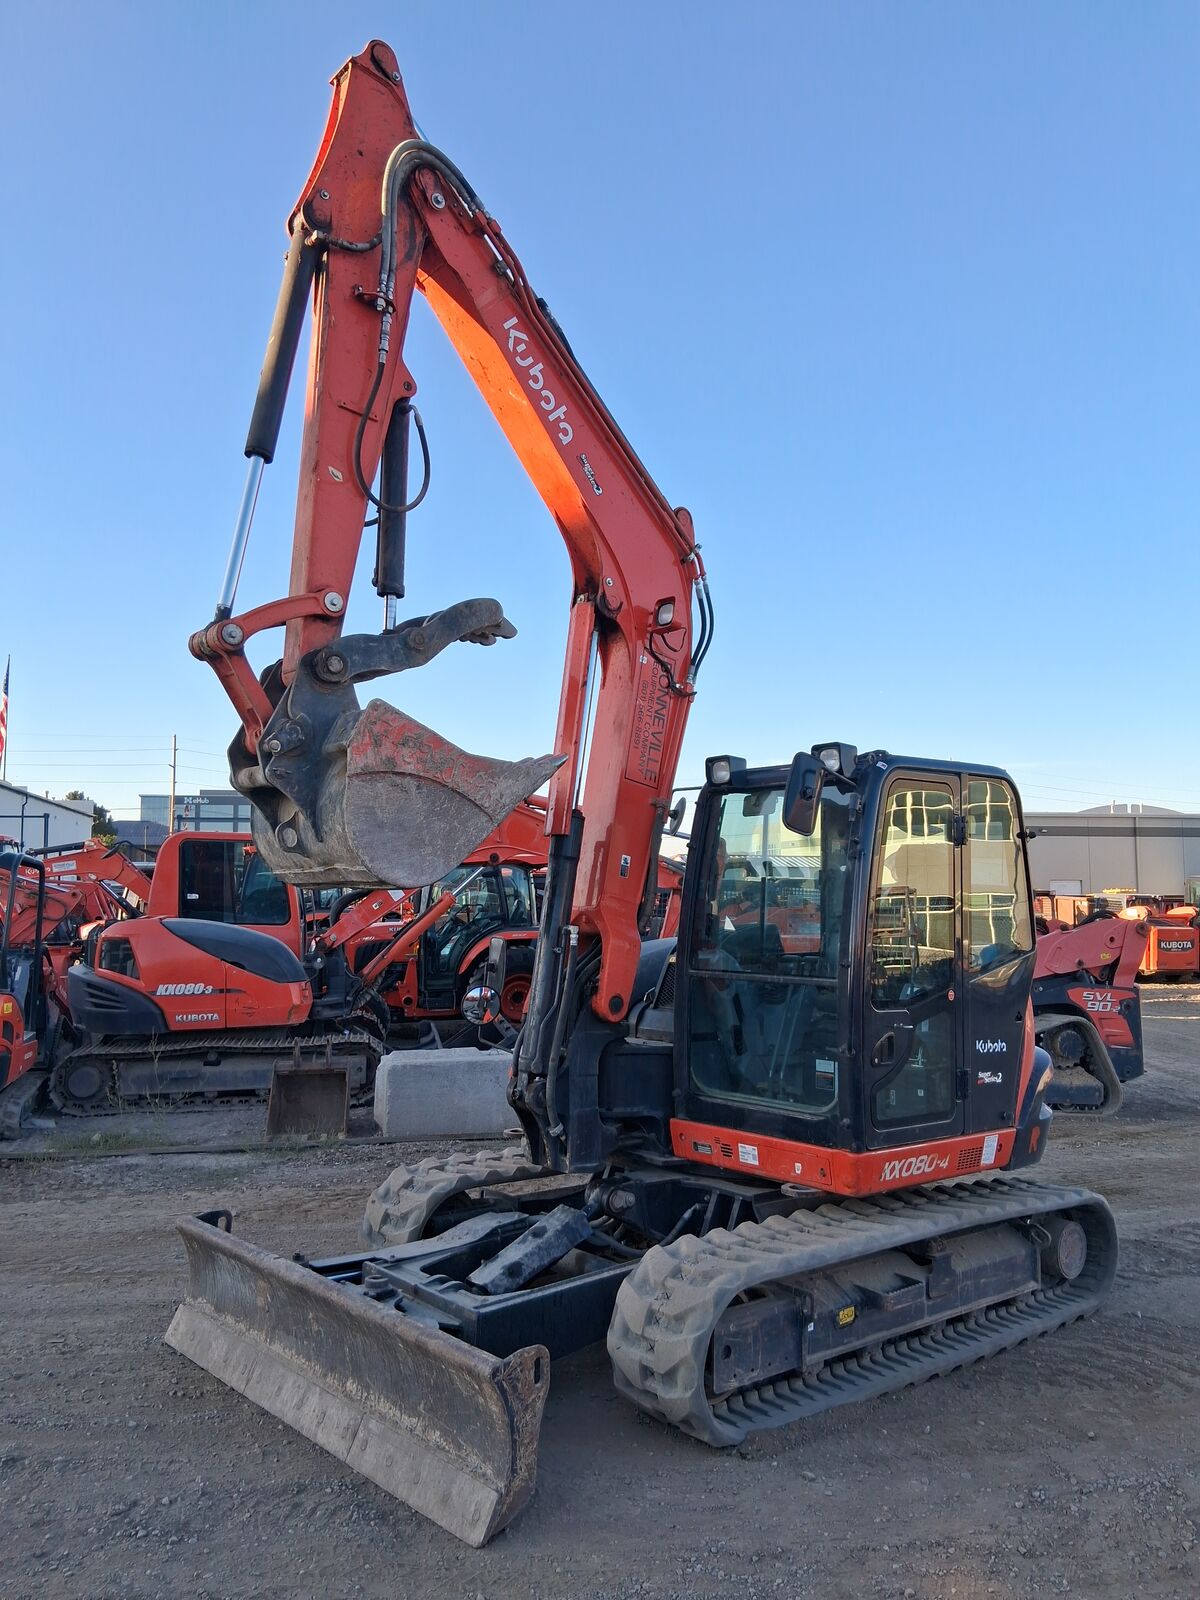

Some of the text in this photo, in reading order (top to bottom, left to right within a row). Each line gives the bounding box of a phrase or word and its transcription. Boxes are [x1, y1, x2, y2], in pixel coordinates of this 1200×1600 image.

[503, 316, 574, 446] Kubota
[638, 660, 660, 775] EQUIPMENT COMPANY
[645, 663, 671, 784] ONNEVILLE
[1160, 941, 1193, 949] KUBOTA
[156, 983, 213, 996] KX080-3
[1082, 991, 1117, 1001] SVL
[175, 1013, 220, 1023] KUBOTA
[976, 1039, 1007, 1053] Kubota
[880, 1153, 950, 1182] KX080-4
